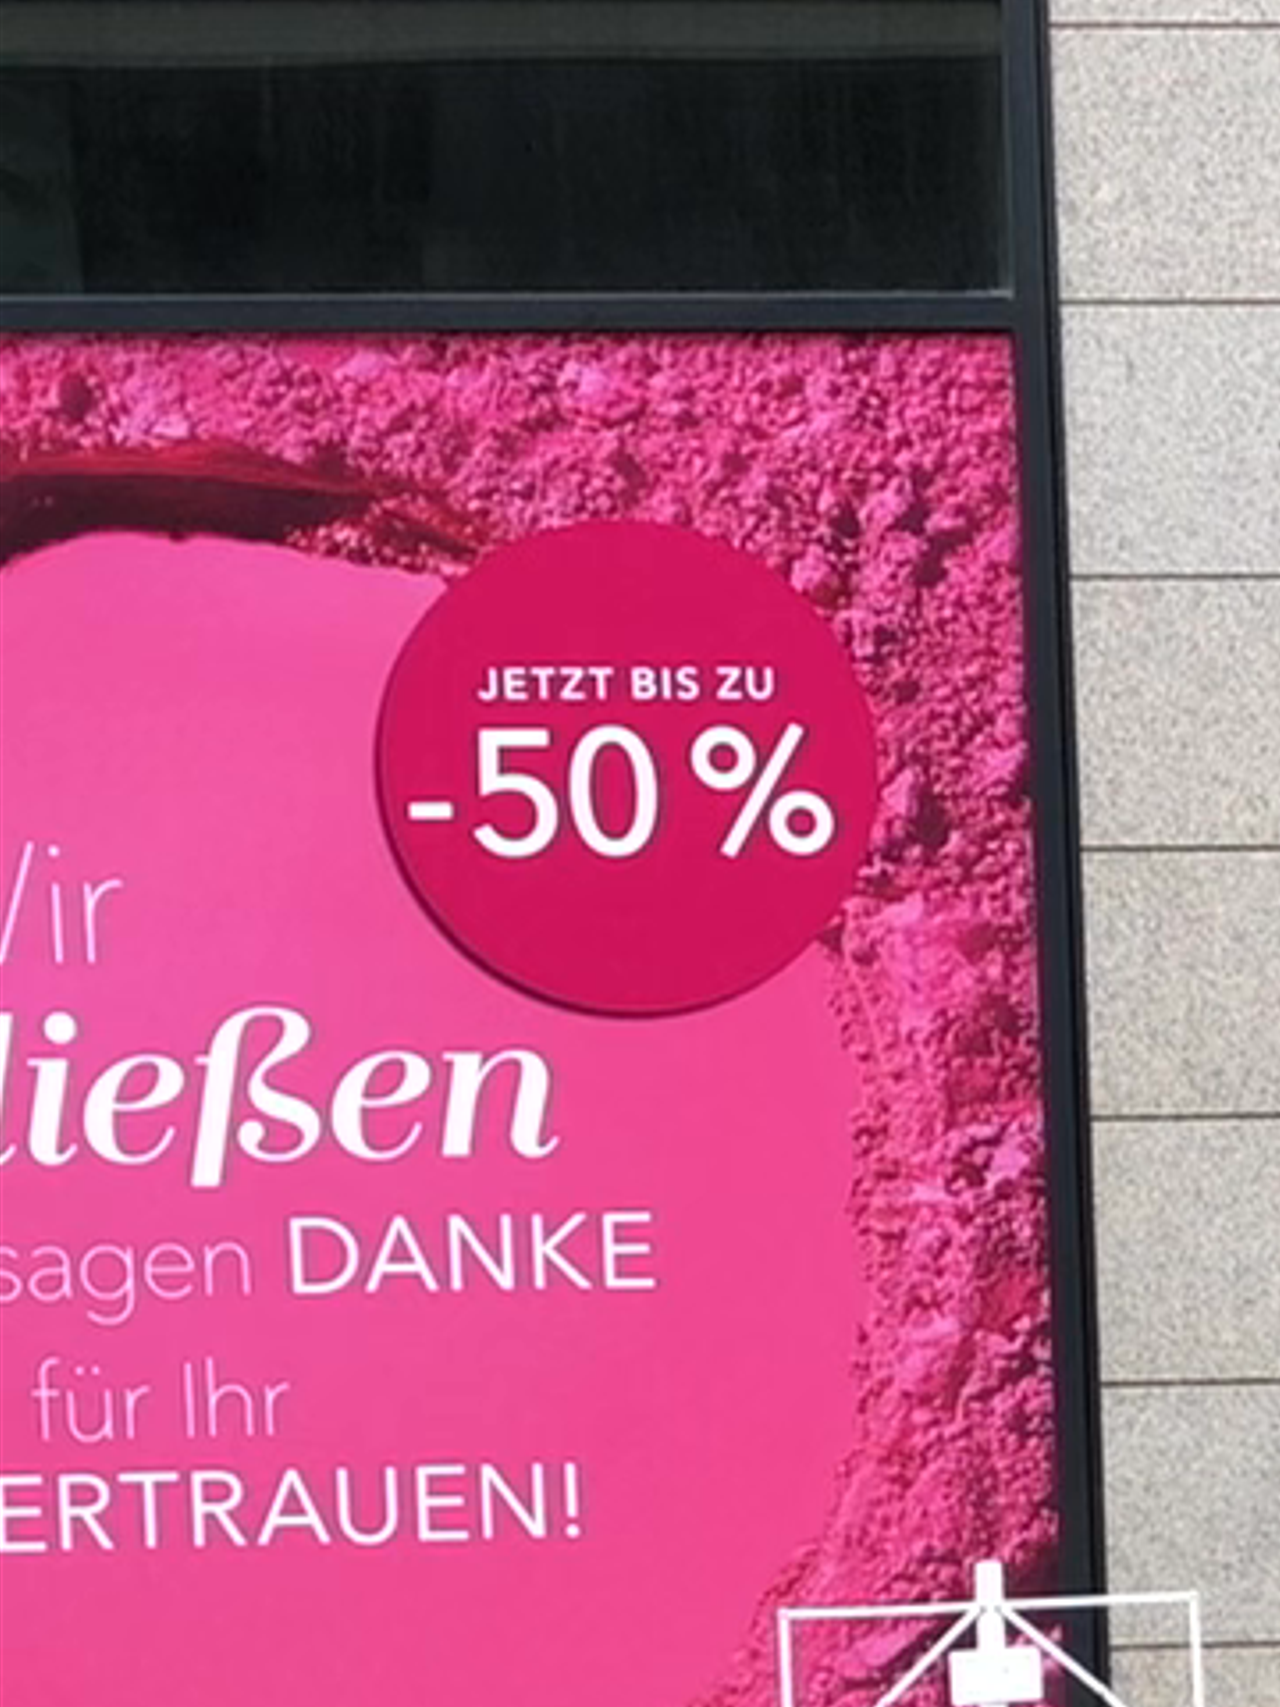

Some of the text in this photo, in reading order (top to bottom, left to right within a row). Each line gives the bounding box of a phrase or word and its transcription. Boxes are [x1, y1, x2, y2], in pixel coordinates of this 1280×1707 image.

[477, 666, 776, 702] JETZT BIS ZU
[0, 841, 124, 964] ir
[288, 1212, 656, 1295] DANKE
[31, 1356, 290, 1443] für Ihr
